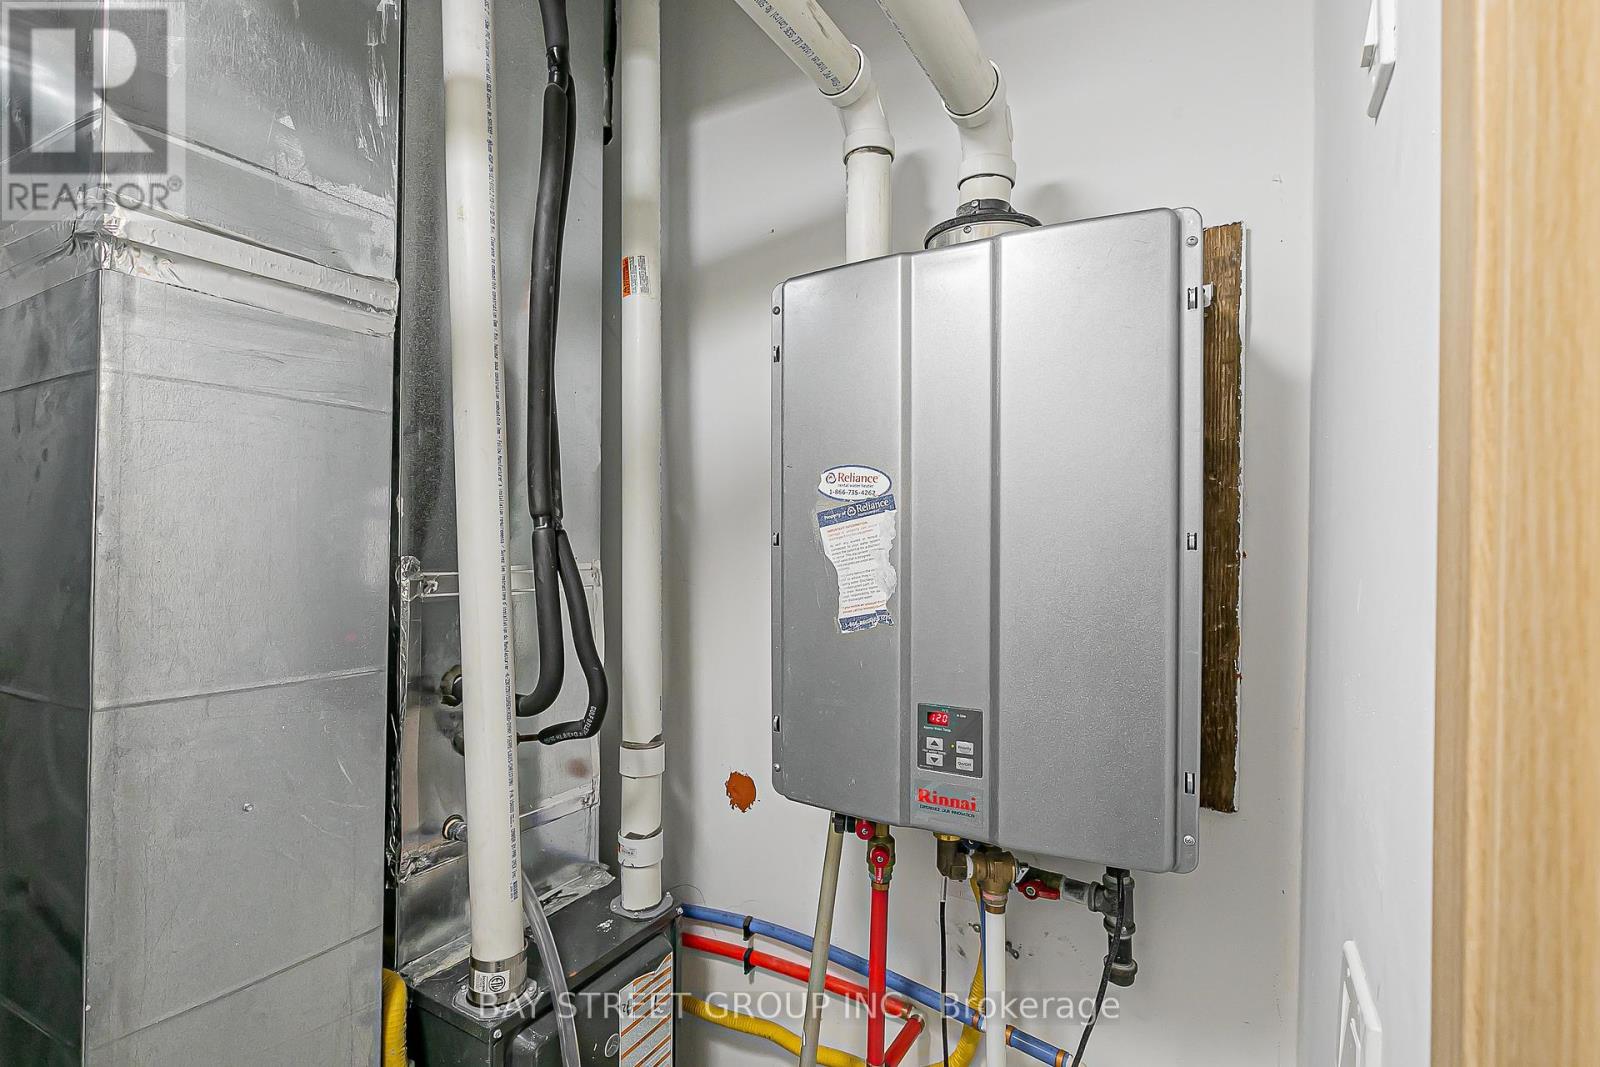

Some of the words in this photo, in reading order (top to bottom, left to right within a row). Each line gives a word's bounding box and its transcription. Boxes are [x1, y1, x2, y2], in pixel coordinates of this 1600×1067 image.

[771, 11, 788, 29] Control
[838, 472, 878, 483] Reliance
[856, 500, 889, 513] Reliance
[932, 714, 948, 723] 120
[918, 788, 976, 812] Rinnai
